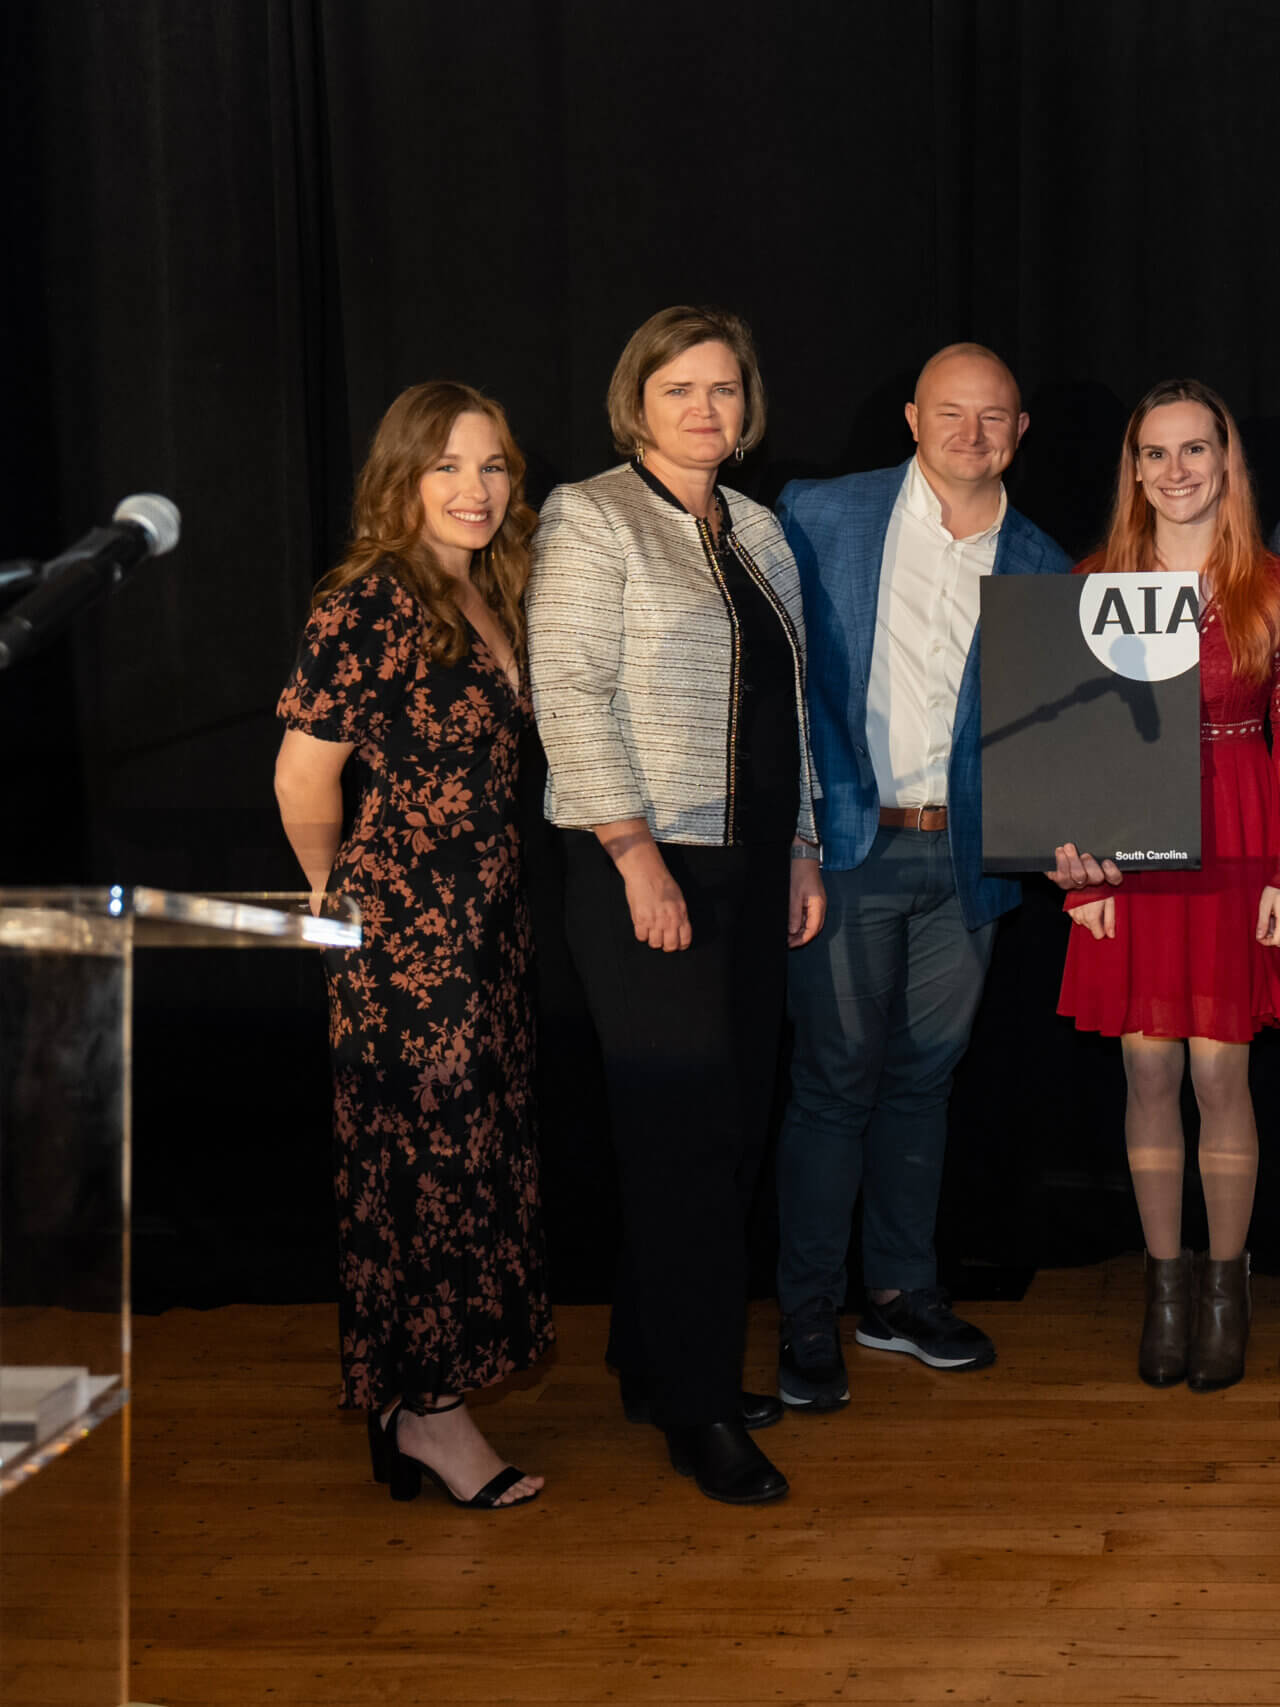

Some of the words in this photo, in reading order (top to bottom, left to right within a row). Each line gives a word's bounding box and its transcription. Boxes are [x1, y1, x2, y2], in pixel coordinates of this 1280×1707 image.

[1092, 587, 1200, 634] AIA
[1115, 850, 1145, 861] South
[1147, 849, 1188, 860] Carolina
